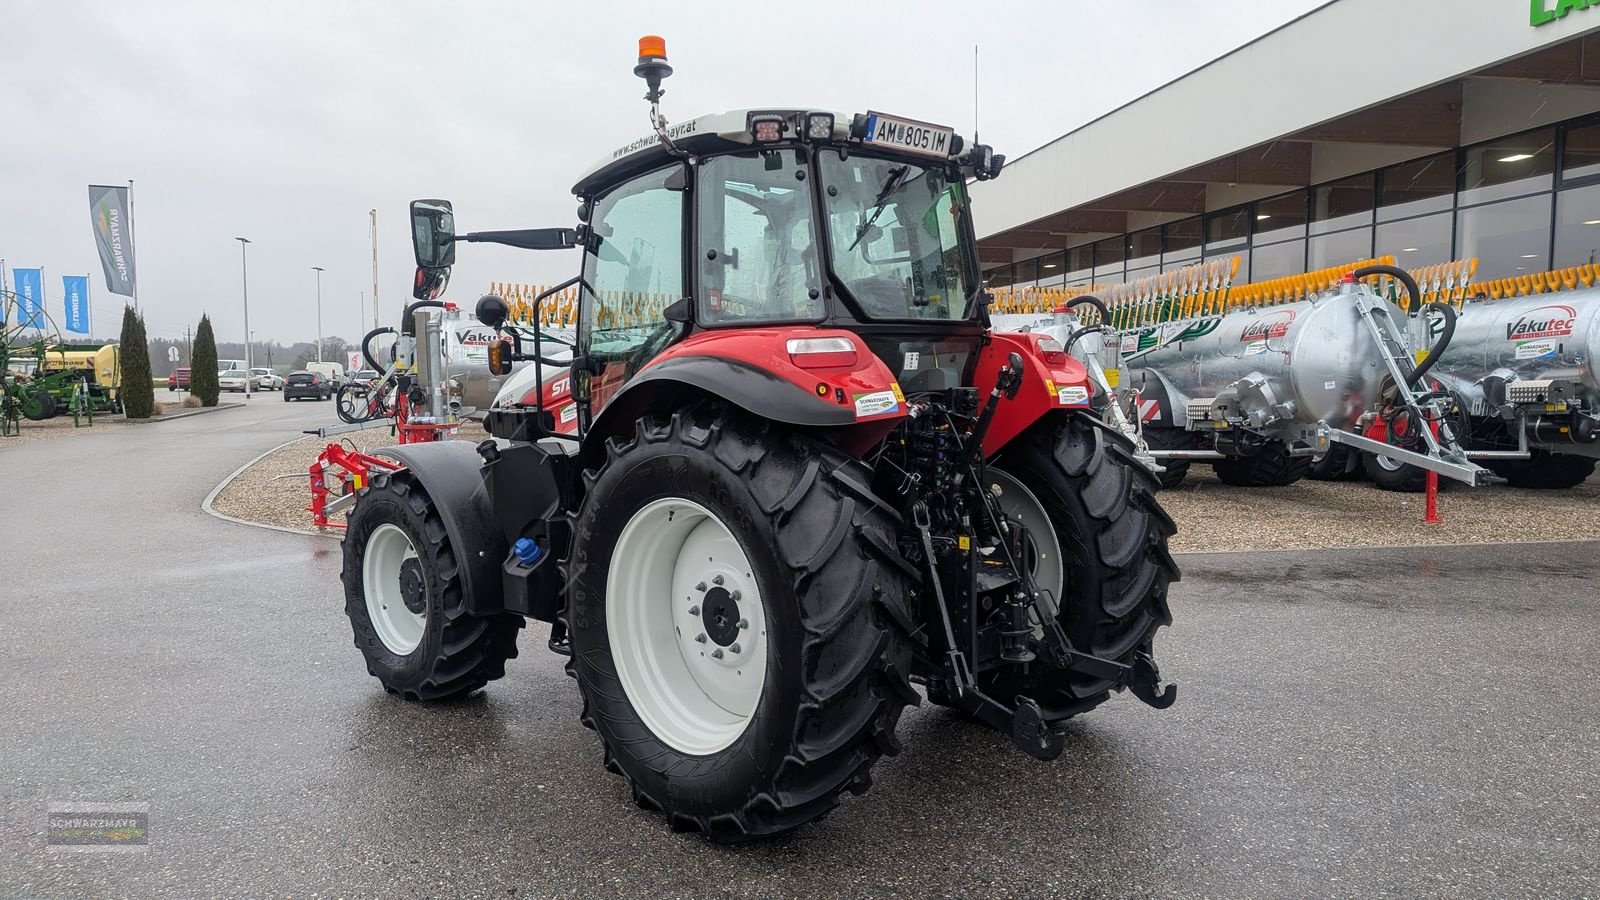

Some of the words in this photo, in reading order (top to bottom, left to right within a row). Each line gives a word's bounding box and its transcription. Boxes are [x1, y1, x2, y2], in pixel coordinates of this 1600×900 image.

[877, 121, 897, 143] AM
[905, 126, 931, 149] 805
[931, 131, 946, 152] IM
[1240, 320, 1292, 342] Vakutec
[1507, 317, 1576, 340] Vakutec
